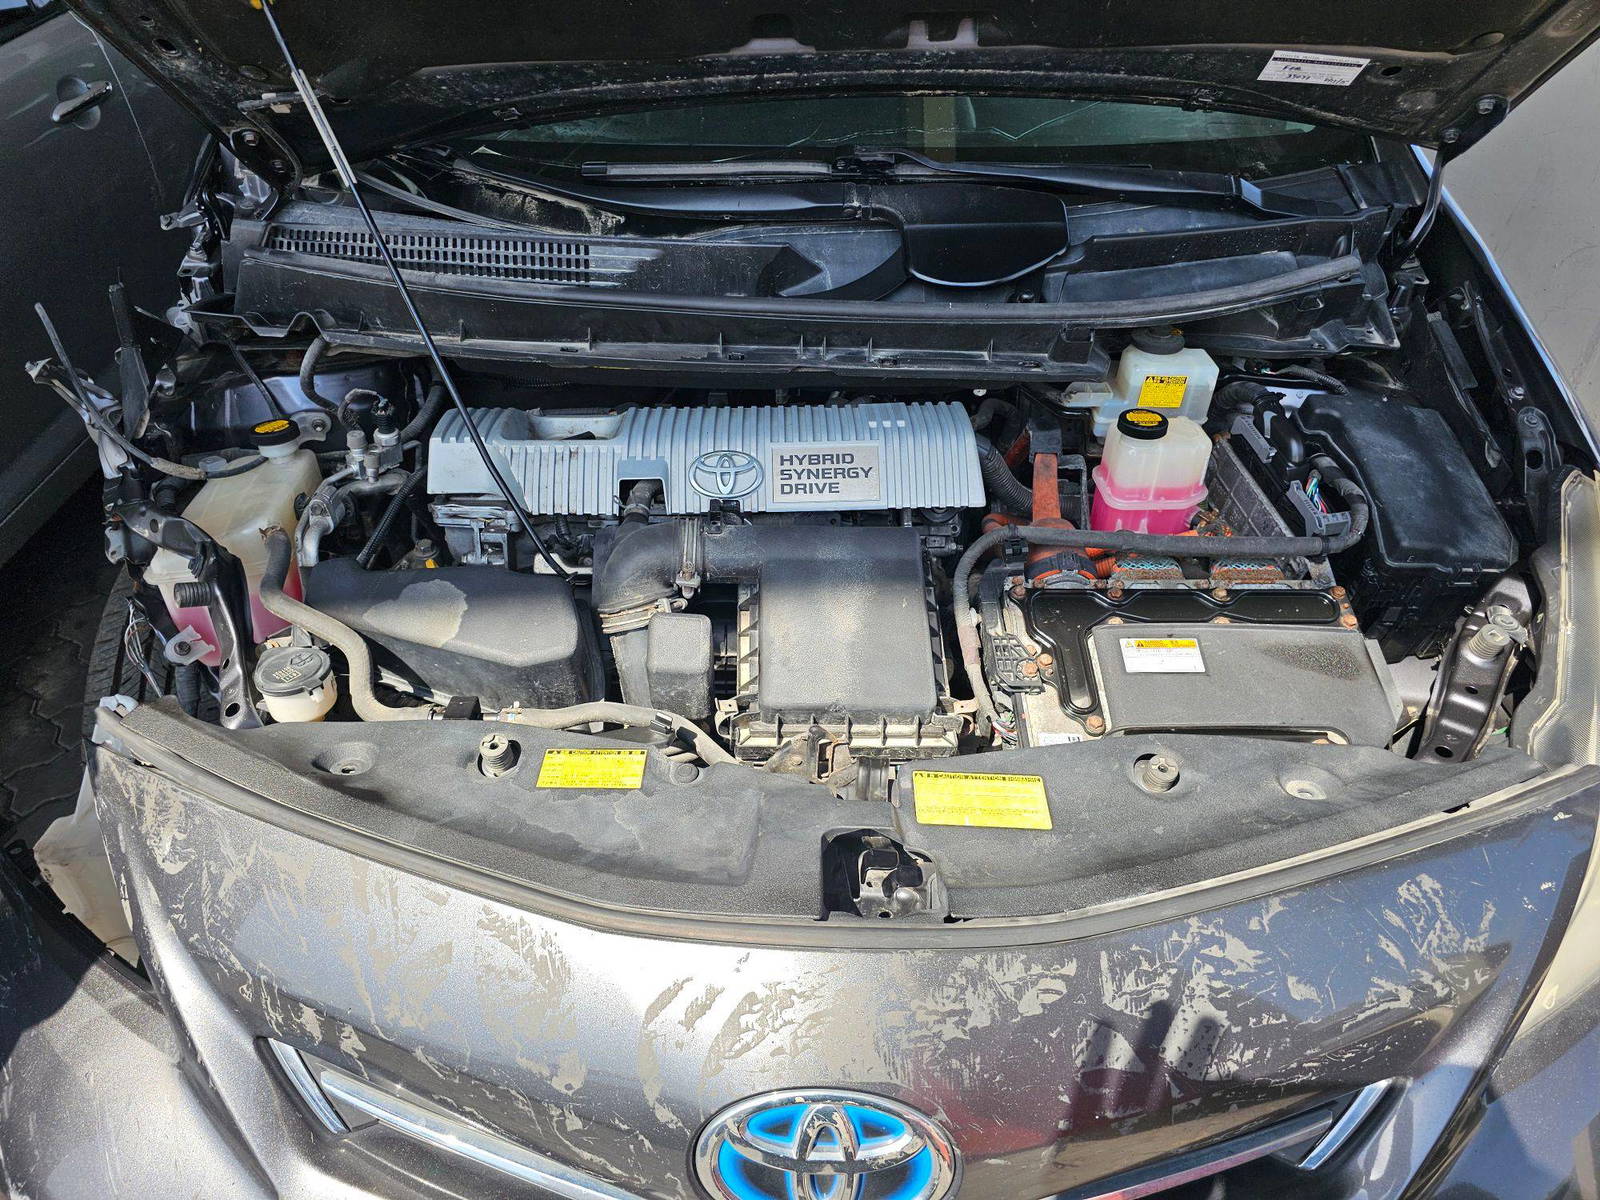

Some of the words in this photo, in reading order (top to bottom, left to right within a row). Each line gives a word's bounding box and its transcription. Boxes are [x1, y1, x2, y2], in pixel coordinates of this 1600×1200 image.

[780, 453, 855, 466] HYBRID
[780, 467, 873, 480] SYNERGY
[780, 482, 840, 495] DRIVE
